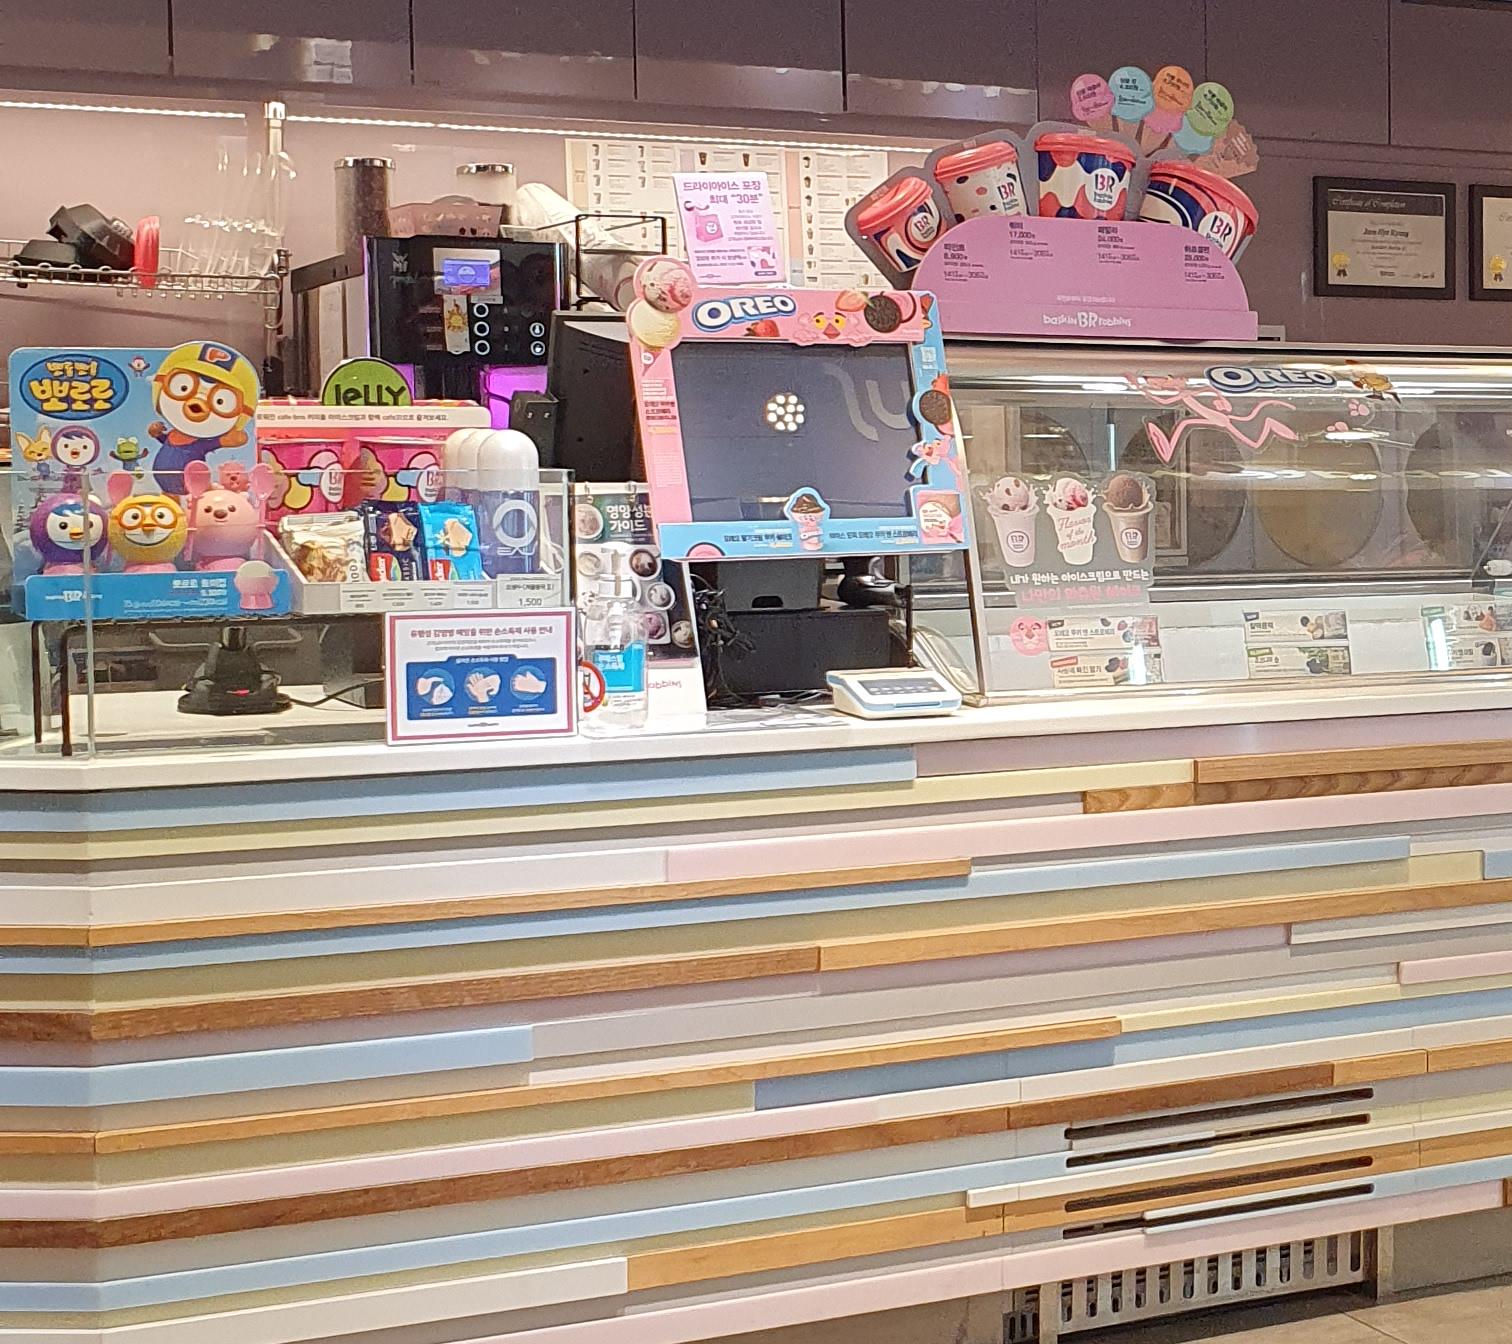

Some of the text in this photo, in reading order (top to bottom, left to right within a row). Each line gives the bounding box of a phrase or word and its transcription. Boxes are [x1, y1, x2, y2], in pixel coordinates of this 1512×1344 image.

[683, 181, 761, 191] 드라이아이스 포장
[997, 180, 1015, 200] BR
[1095, 172, 1115, 192] BR
[915, 215, 930, 233] BR
[1210, 215, 1232, 240] BR
[695, 294, 795, 329] OREO
[1043, 312, 1132, 328] baskin BR robbins
[1208, 366, 1335, 389] OREO
[29, 377, 114, 412] 뽀로로
[609, 519, 648, 533] 가이드
[1010, 569, 1149, 585] 내가 원하는 아이스크림으로 만드는
[518, 596, 543, 607] 1,500
